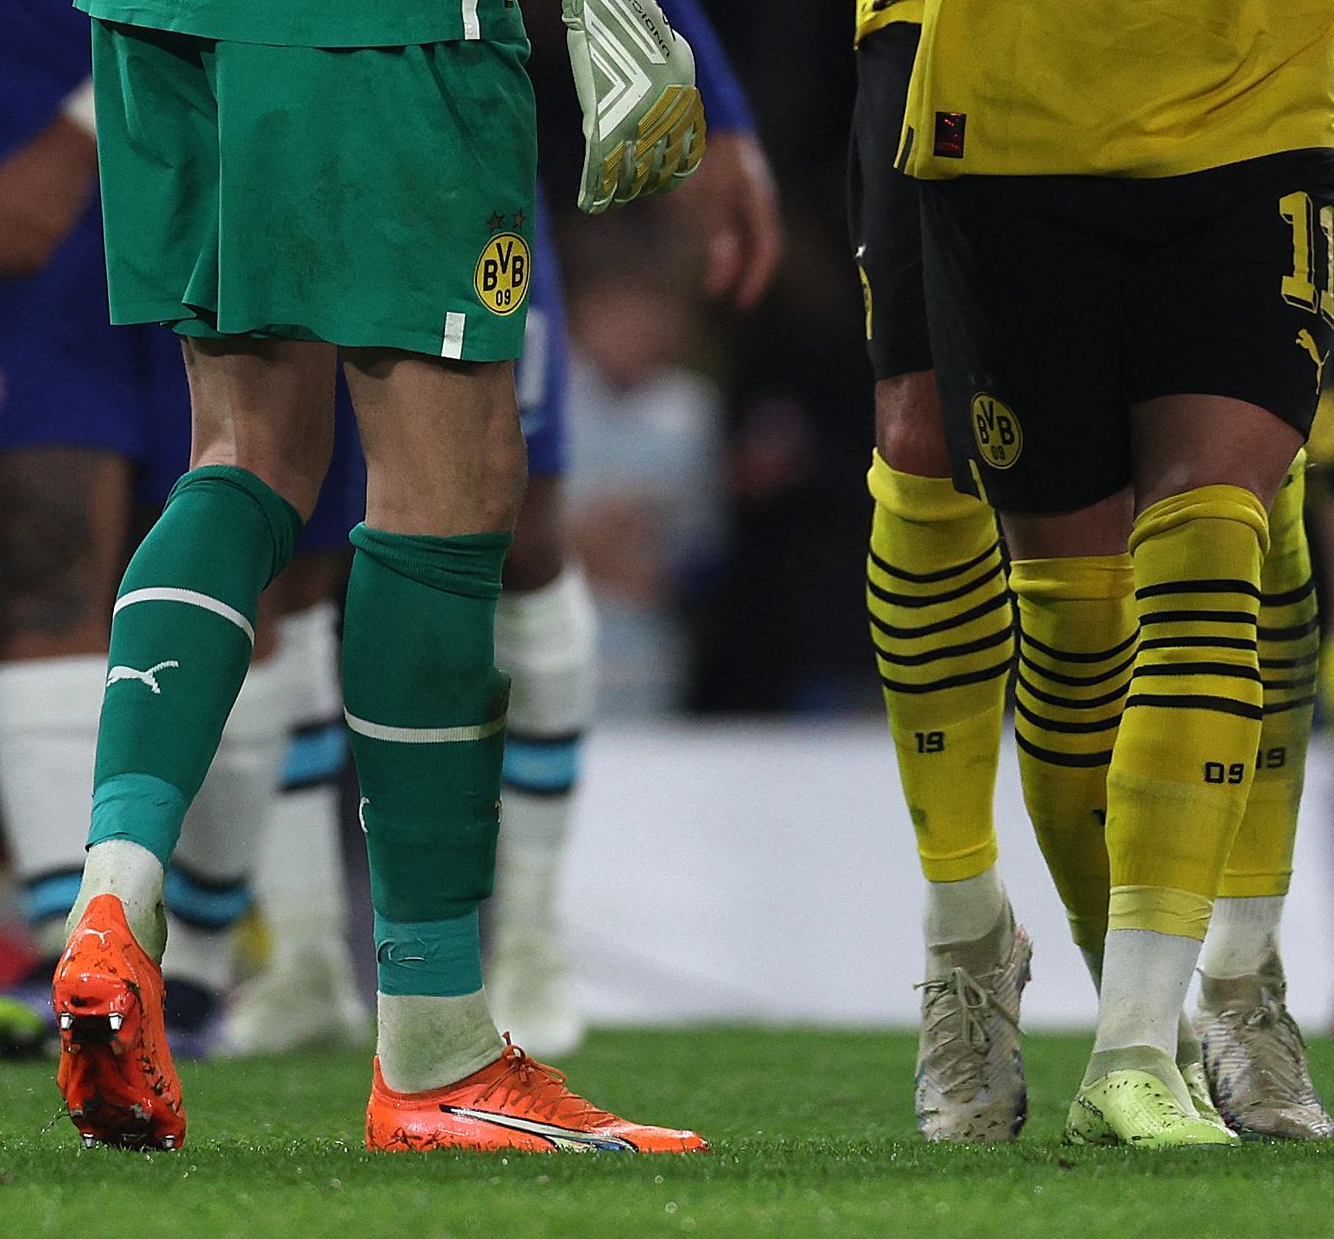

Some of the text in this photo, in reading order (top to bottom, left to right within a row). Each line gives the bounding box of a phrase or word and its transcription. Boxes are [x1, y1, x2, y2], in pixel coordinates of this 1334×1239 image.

[483, 241, 524, 291] BVB
[496, 289, 511, 306] 09
[976, 400, 1015, 445] BVB
[915, 732, 944, 753] 19
[1205, 762, 1244, 784] 09
